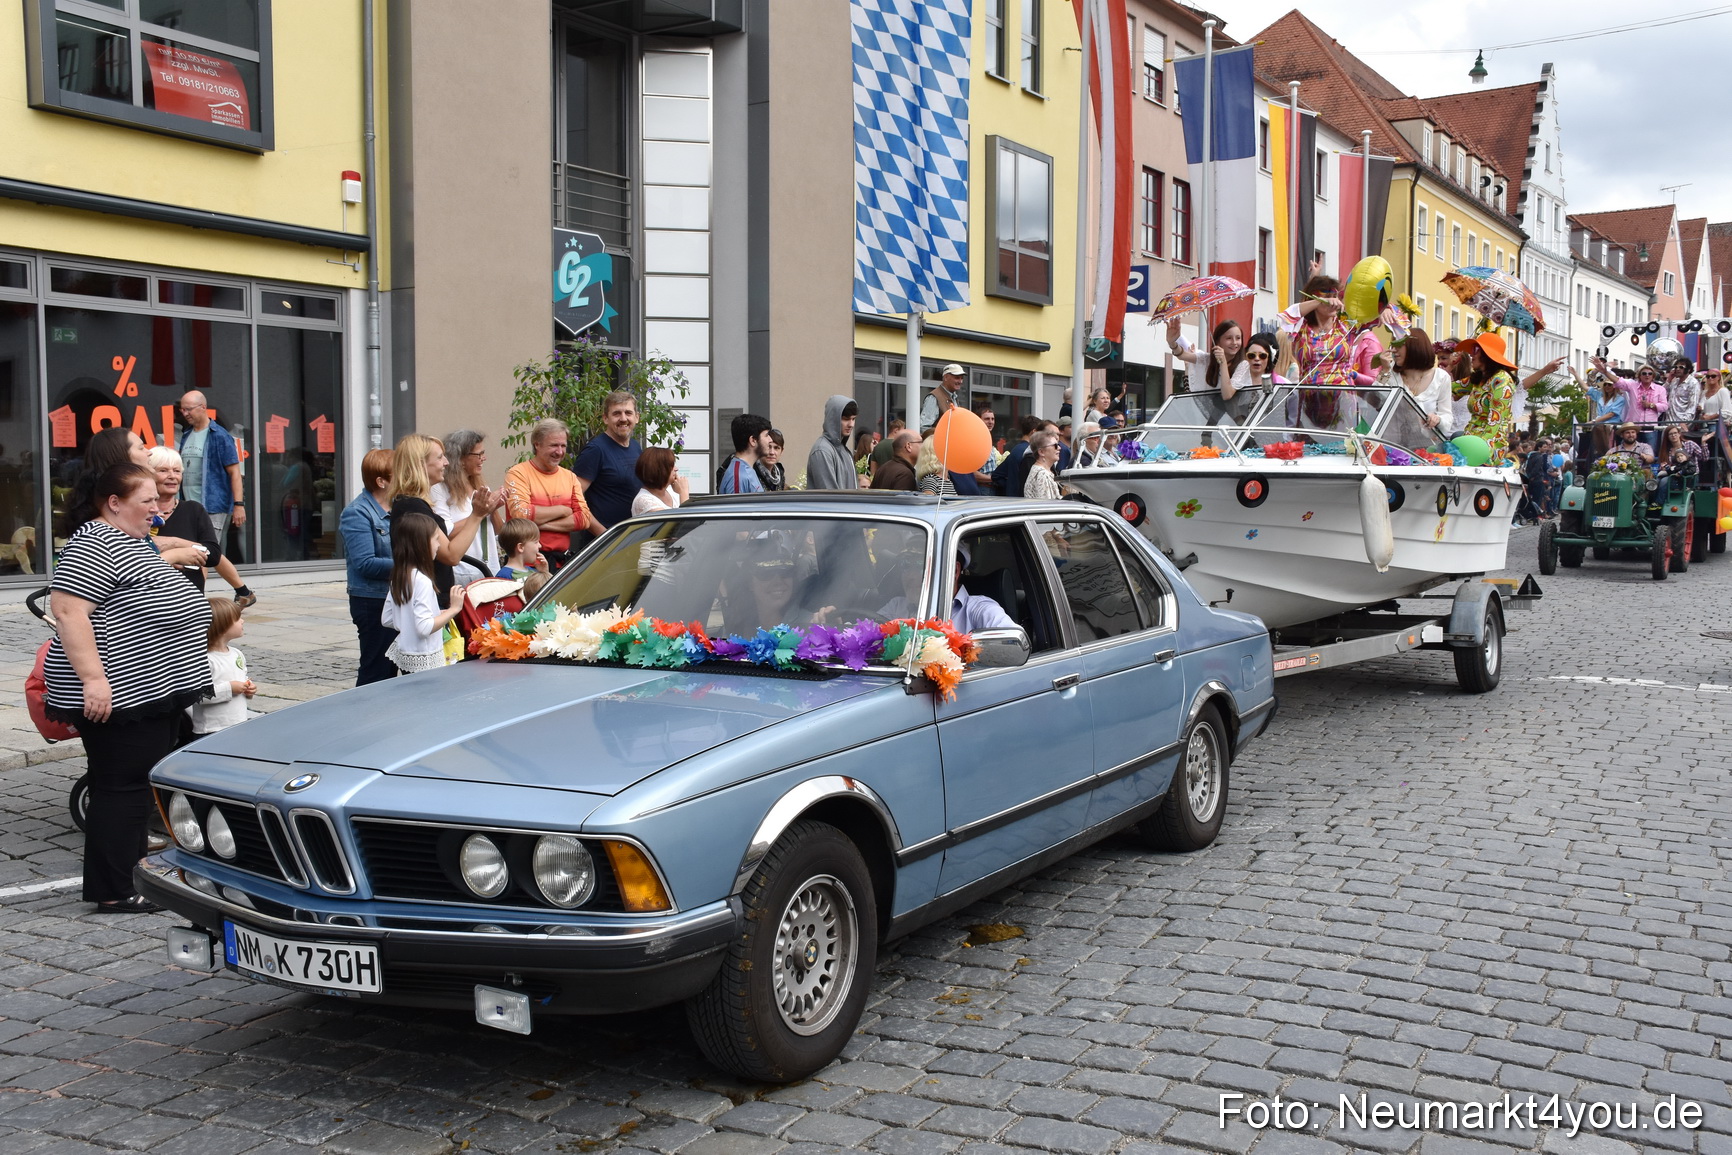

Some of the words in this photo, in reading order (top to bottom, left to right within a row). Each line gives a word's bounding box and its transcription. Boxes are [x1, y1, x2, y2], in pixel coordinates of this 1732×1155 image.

[160, 71, 177, 84] Tel.
[178, 76, 240, 98] 09181/210663
[210, 107, 241, 119] Sparkassen
[558, 250, 592, 308] G2
[235, 929, 264, 969] NM
[274, 942, 295, 977] K
[296, 946, 376, 986] 730H
